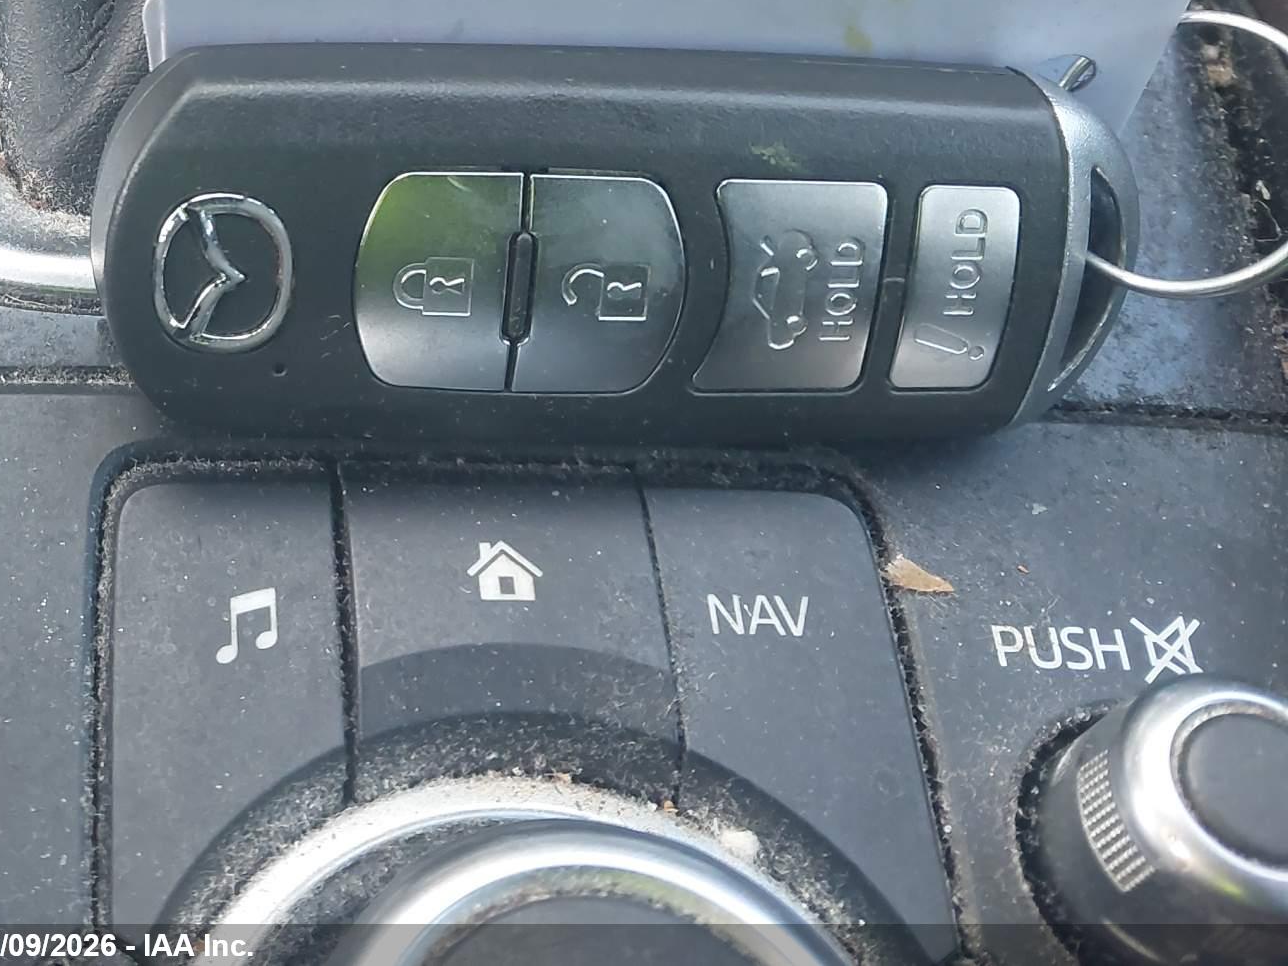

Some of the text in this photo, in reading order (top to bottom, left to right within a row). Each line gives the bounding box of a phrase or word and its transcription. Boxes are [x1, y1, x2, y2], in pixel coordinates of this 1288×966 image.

[819, 238, 864, 341] HOLD
[943, 209, 988, 315] HOLD
[707, 593, 809, 637] NAV
[991, 624, 1131, 671] PUSH
